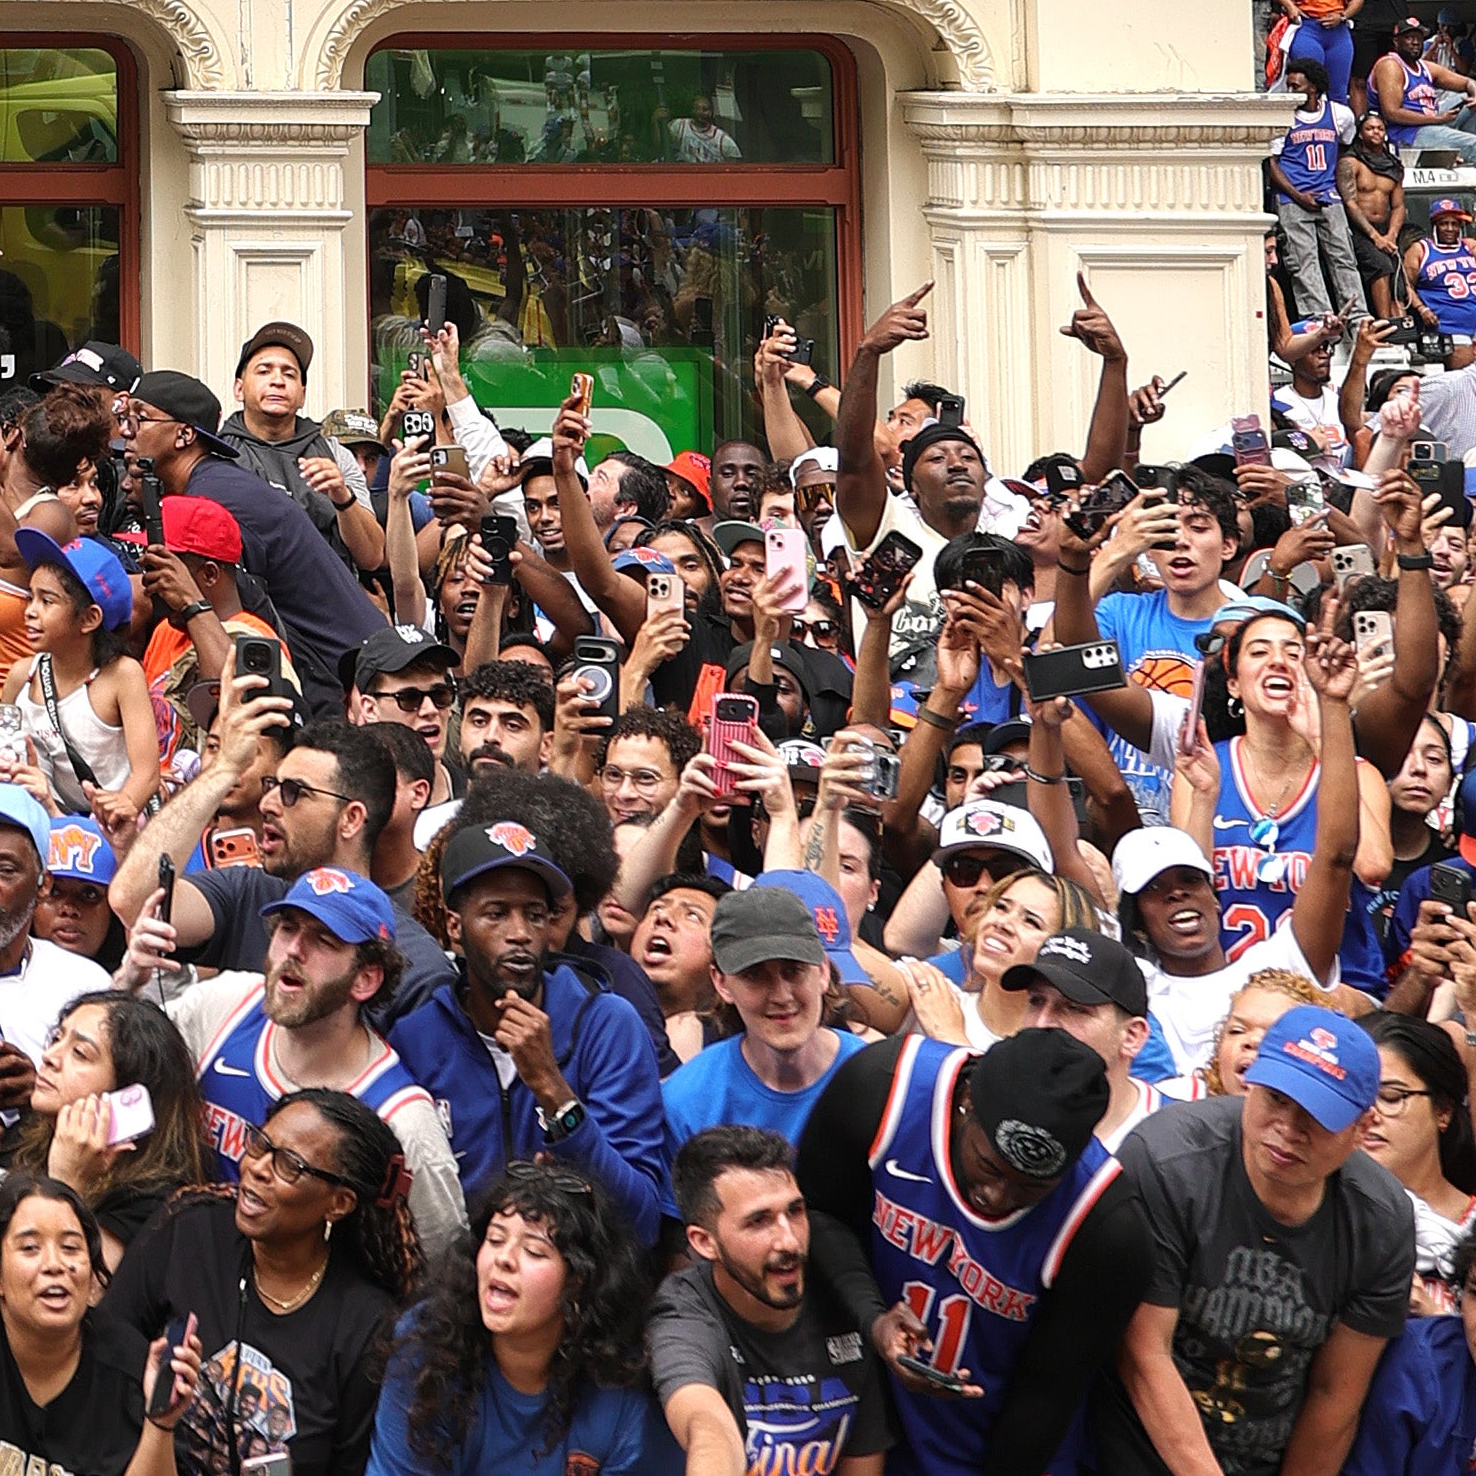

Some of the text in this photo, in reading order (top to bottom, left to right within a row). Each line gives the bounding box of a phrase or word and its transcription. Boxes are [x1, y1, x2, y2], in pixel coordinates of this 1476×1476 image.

[1306, 144, 1327, 171] 11
[47, 823, 101, 873] NY
[1212, 845, 1269, 892] EW
[1283, 1041, 1347, 1081] CHAMPIONS
[872, 1189, 1037, 1322] NEW YORK
